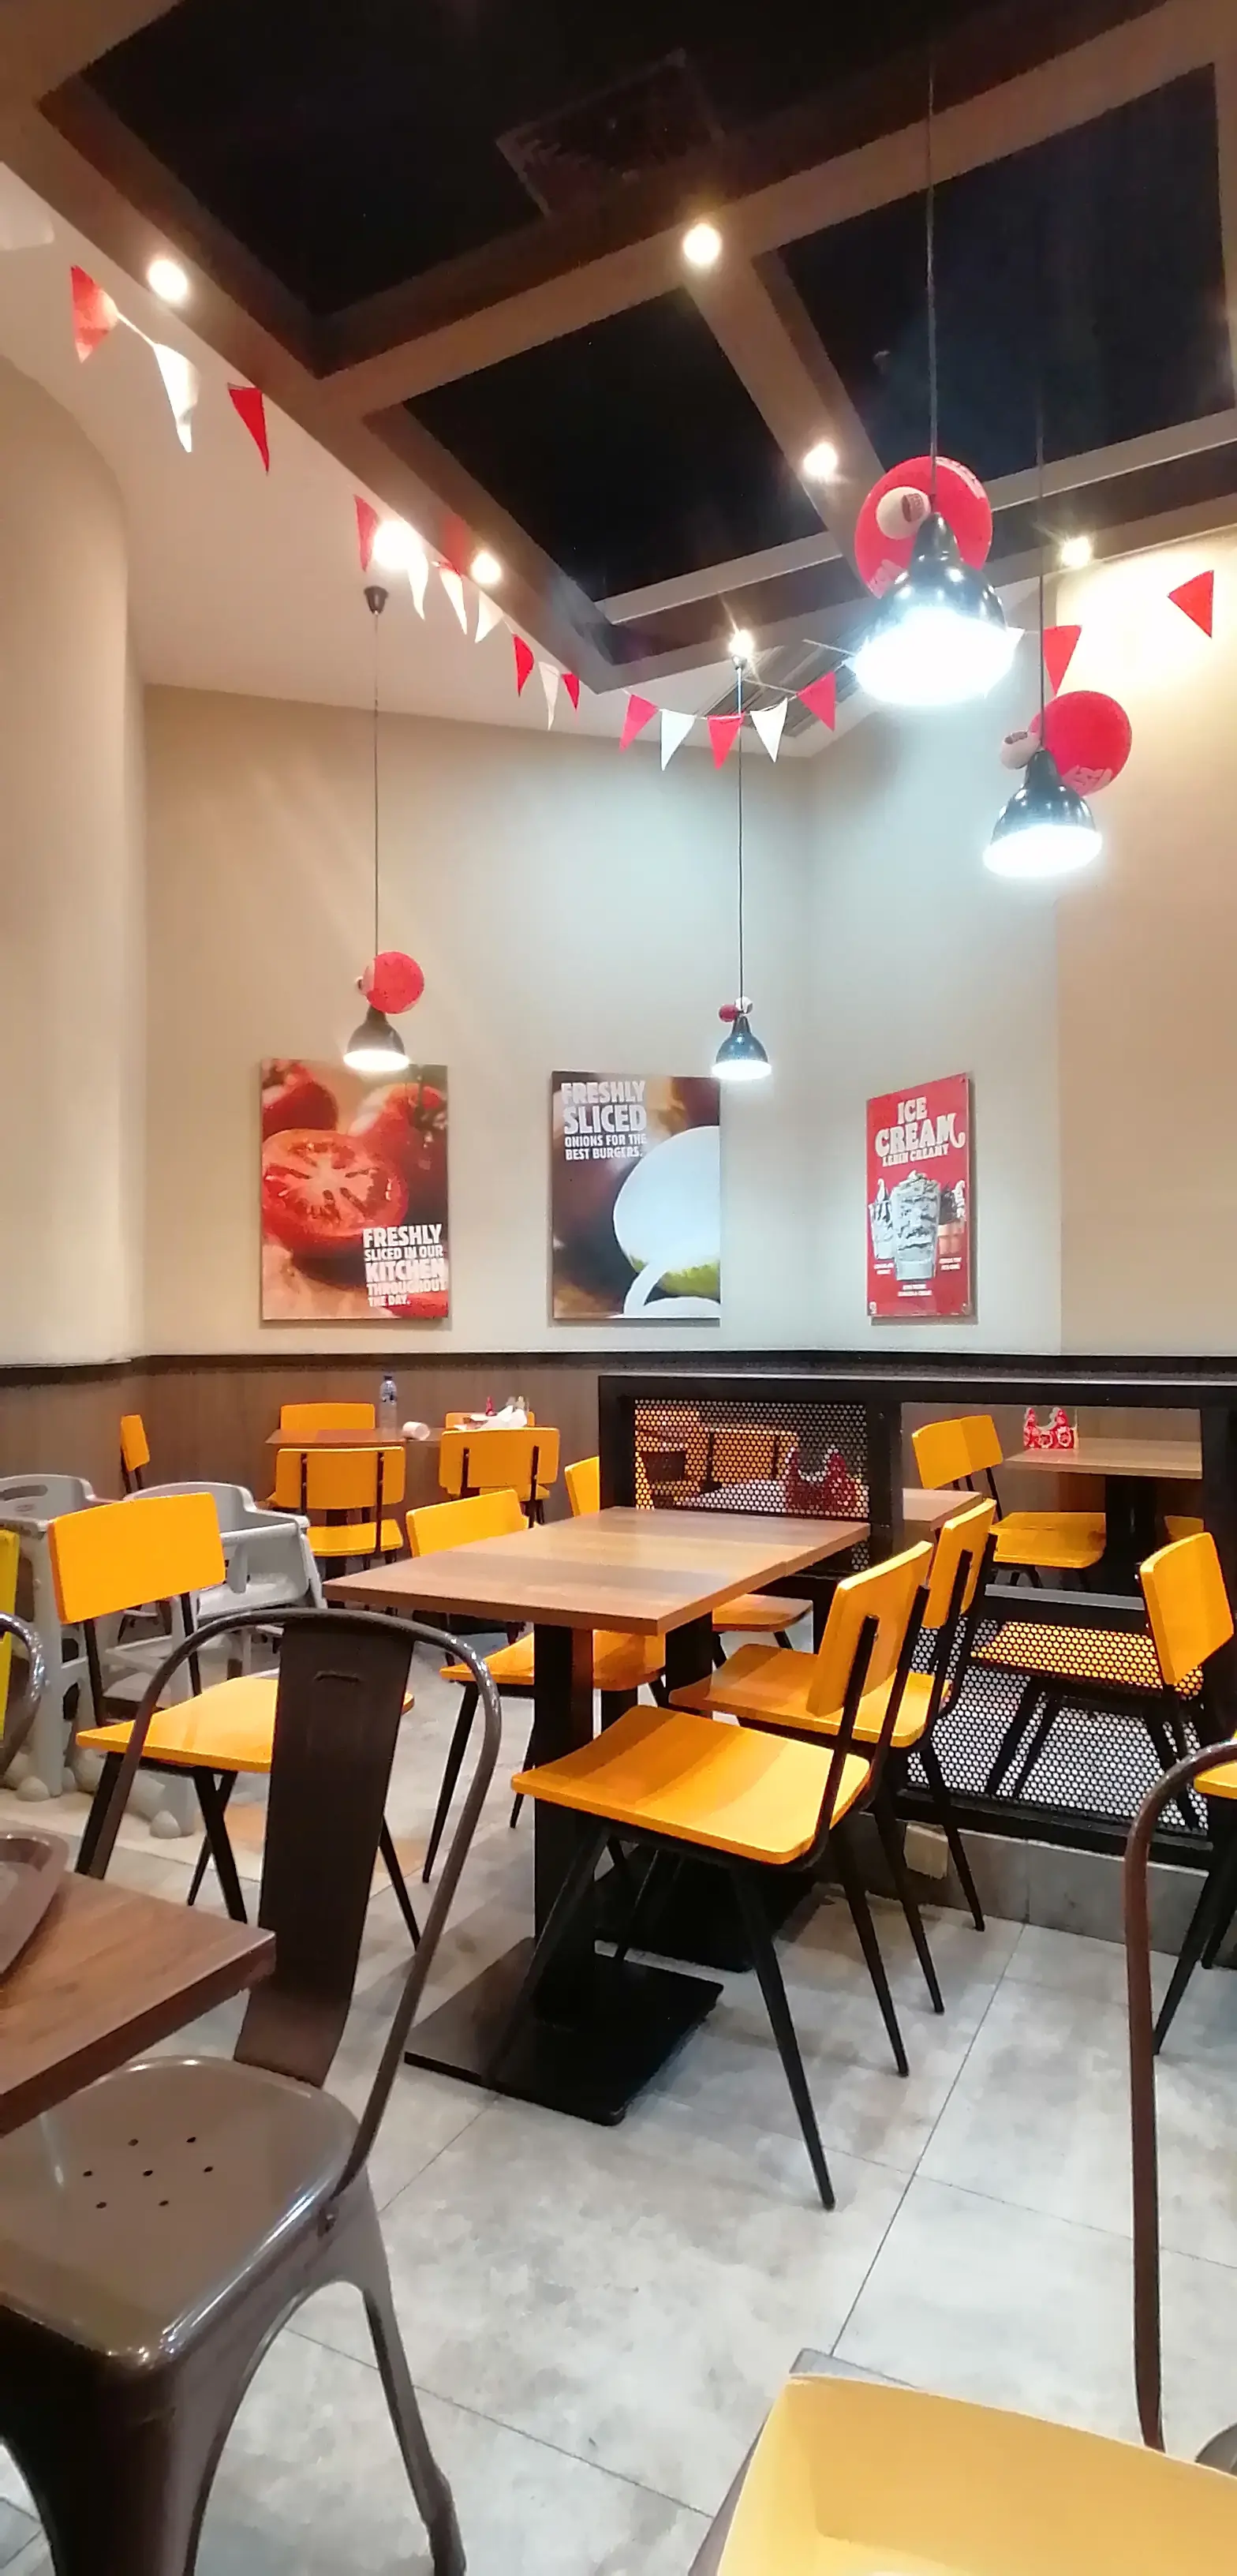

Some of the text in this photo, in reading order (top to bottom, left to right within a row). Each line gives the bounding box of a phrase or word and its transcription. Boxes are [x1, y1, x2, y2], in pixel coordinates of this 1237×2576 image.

[561, 1080, 645, 1104] FRESHLY
[563, 1104, 647, 1135] SLICED
[897, 1096, 928, 1125] ICE
[565, 1133, 648, 1148] ONIONS FOR THE
[875, 1112, 966, 1158] CREAM
[566, 1148, 589, 1161] BEST
[910, 1143, 949, 1162] CREAMY
[363, 1223, 443, 1249] FRESHLY
[364, 1245, 444, 1262] SLICED IN OUR
[365, 1257, 446, 1283] KITCHEN
[368, 1294, 411, 1308] THE DAY.
